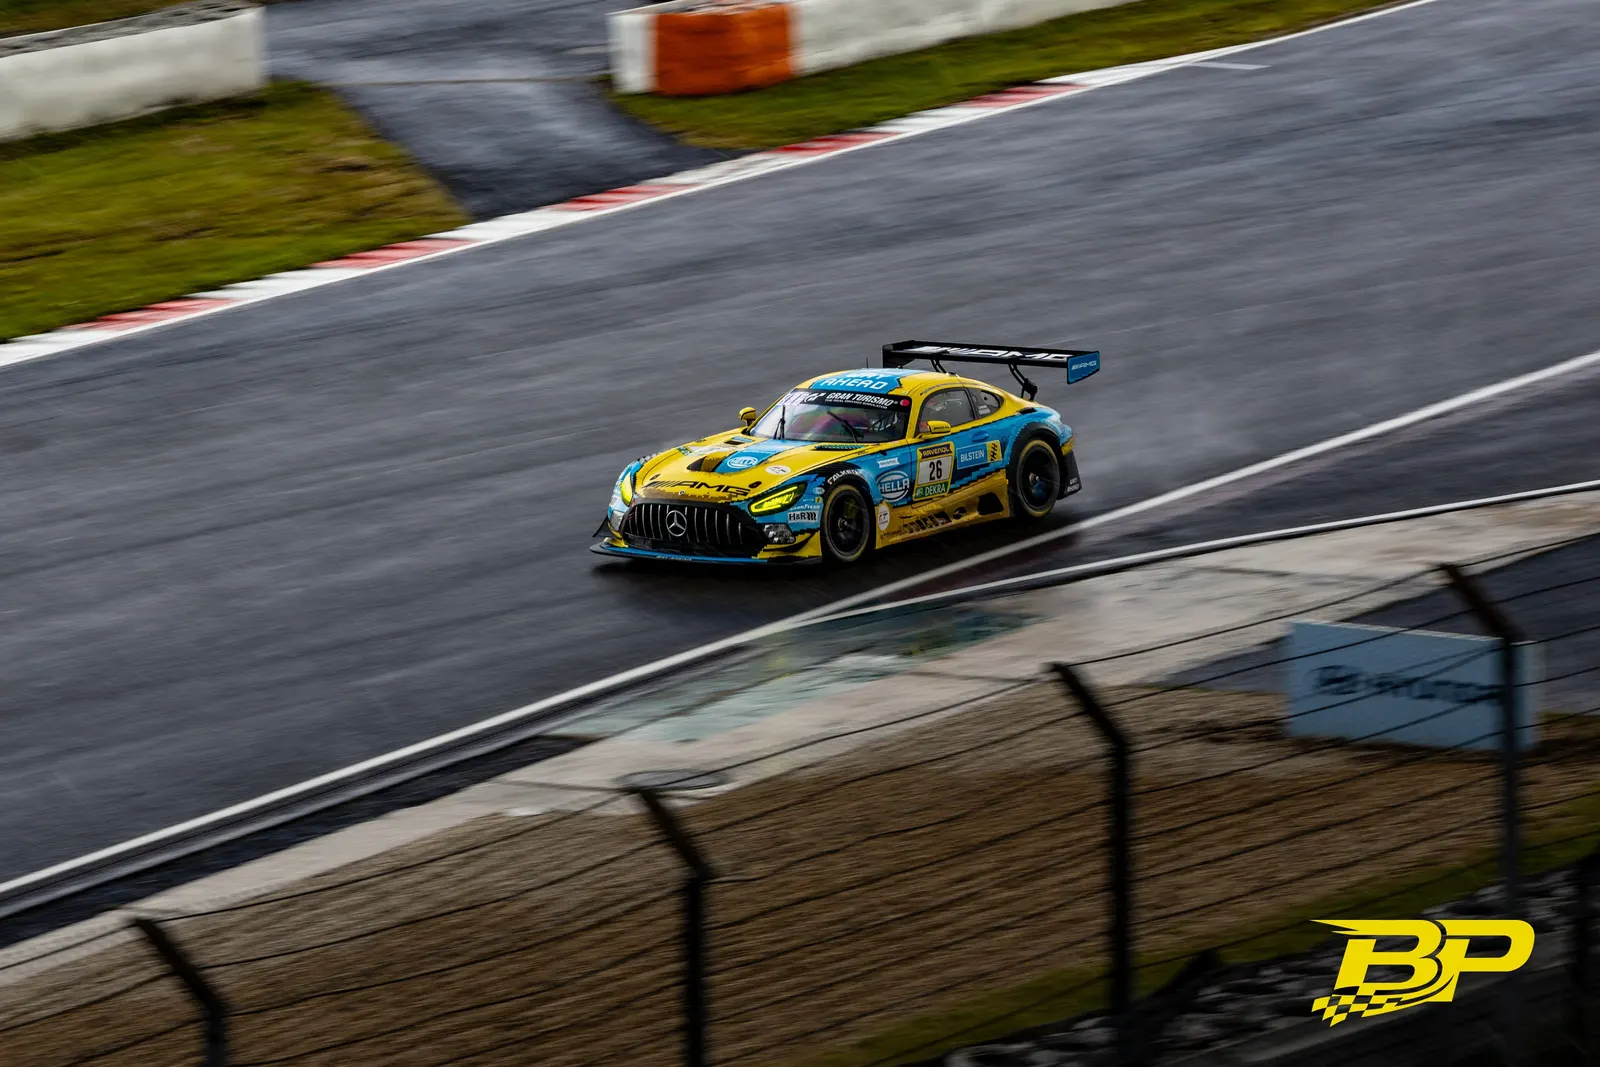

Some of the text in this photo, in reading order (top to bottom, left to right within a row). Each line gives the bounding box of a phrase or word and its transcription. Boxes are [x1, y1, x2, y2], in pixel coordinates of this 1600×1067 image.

[819, 377, 888, 390] AHEAD
[826, 392, 893, 407] GRAN TURISMO
[922, 446, 950, 457] RAVENOL
[960, 449, 985, 463] BILSTEIN
[929, 459, 943, 481] 26
[671, 480, 751, 497] AMG
[880, 477, 910, 493] HELLA
[924, 483, 946, 496] DEKRA
[788, 511, 806, 521] H&R
